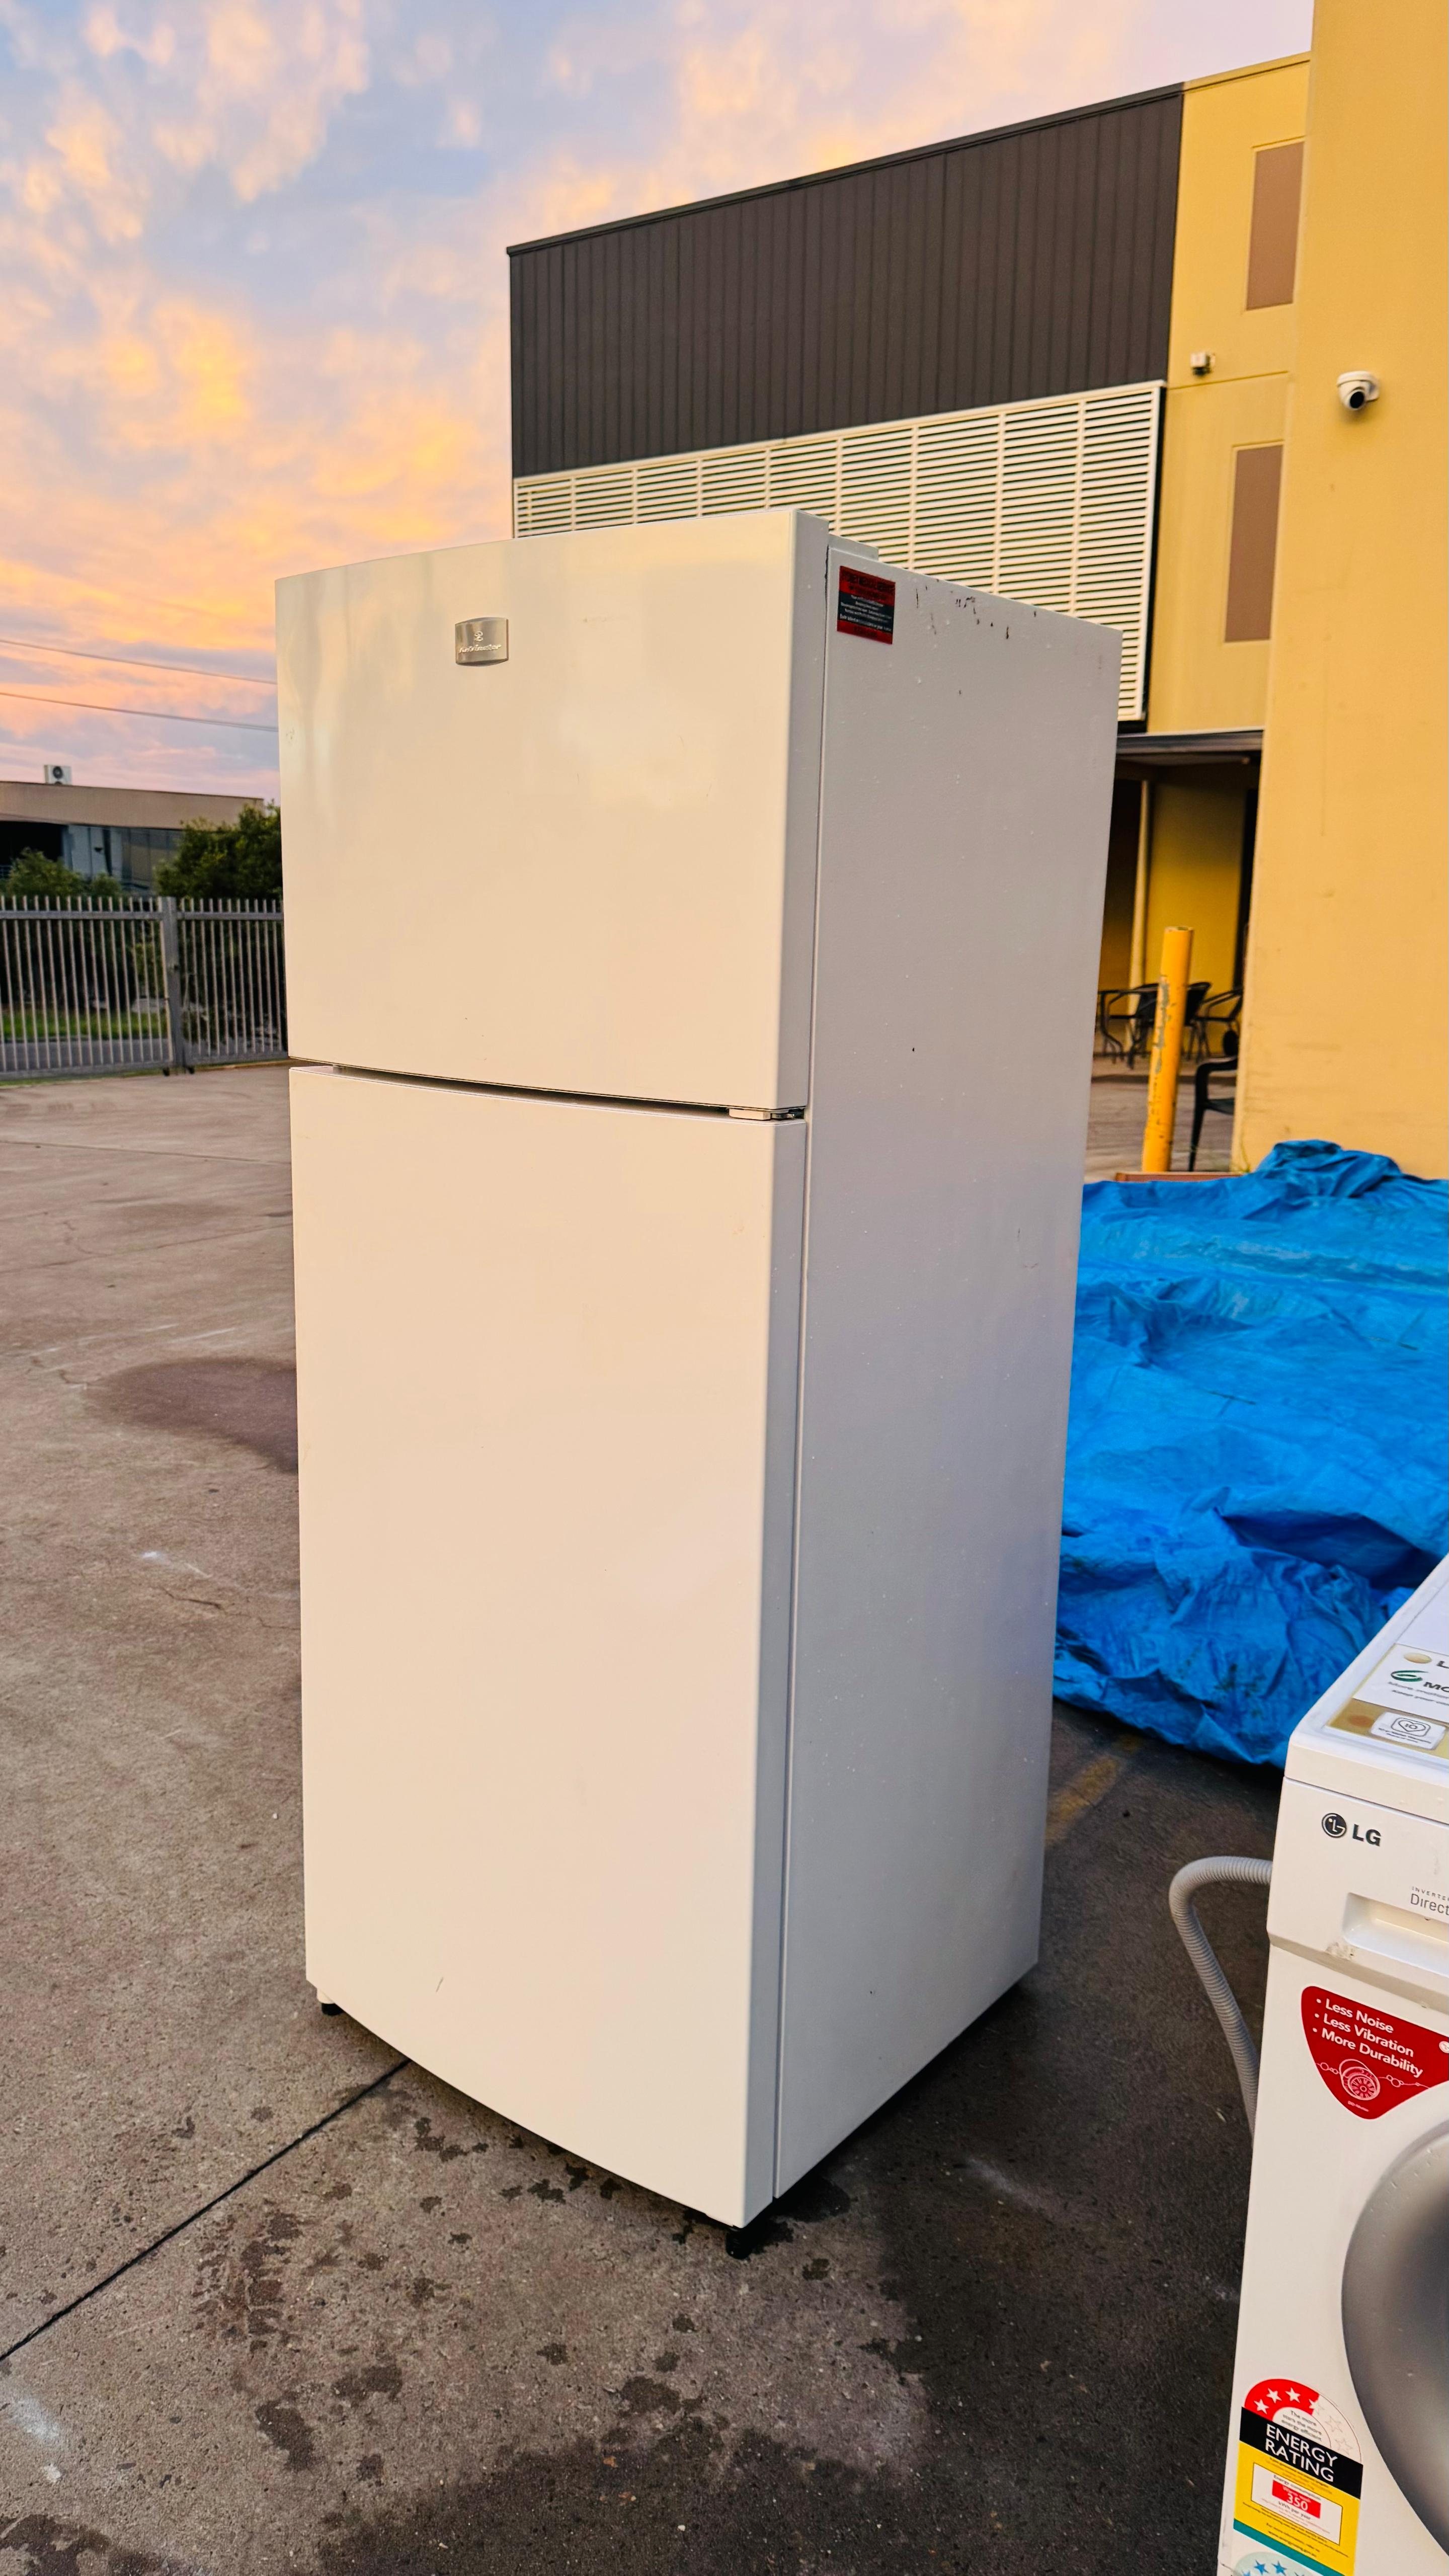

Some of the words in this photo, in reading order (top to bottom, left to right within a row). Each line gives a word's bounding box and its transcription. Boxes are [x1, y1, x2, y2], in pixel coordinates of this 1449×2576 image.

[1352, 1824, 1382, 1846] LG
[1411, 1893, 1449, 1915] Direct
[1323, 2013, 1351, 2033] Less
[1354, 2025, 1414, 2057] Vibration
[1326, 1998, 1353, 2018] Less
[1356, 2010, 1394, 2033] Noise
[1322, 2028, 1356, 2050] More
[1359, 2043, 1423, 2078] Durability
[1265, 2438, 1334, 2482] RATING
[1266, 2424, 1338, 2467] ENERGY
[1286, 2493, 1308, 2511] 350
